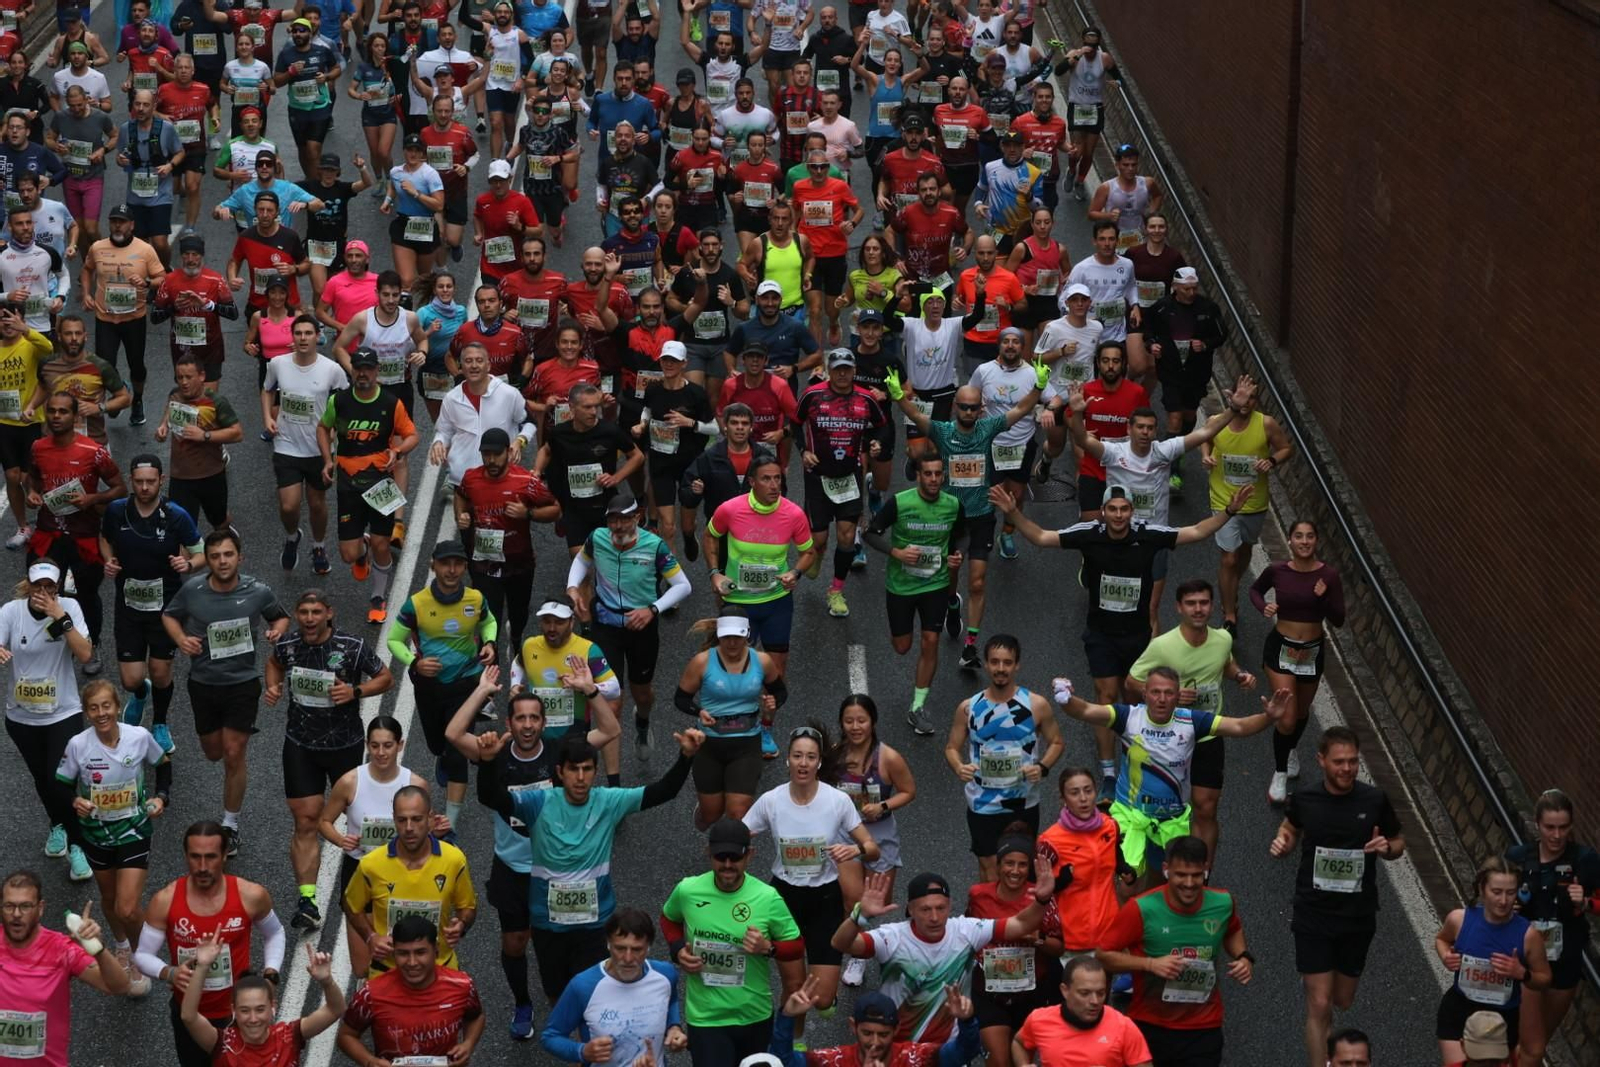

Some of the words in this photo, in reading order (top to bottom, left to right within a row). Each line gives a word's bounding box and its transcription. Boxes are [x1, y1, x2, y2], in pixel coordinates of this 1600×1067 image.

[109, 293, 129, 303] 9601
[285, 398, 308, 411] 7928
[816, 420, 865, 431] TRISPORT
[954, 463, 977, 474] 5341
[1227, 461, 1250, 474] 7592
[743, 572, 769, 584] 8263
[128, 586, 155, 599] 9068
[1103, 585, 1134, 598] 10413
[214, 629, 242, 643] 9924
[17, 684, 50, 698] 15094
[296, 677, 324, 692] 8258
[984, 758, 1013, 772] 7925
[94, 790, 131, 806] 12417
[364, 826, 397, 840] 1002
[785, 846, 816, 860] 6904
[1321, 859, 1354, 874] 7625
[556, 892, 587, 906] 8528
[700, 951, 734, 969] 9045
[0, 1022, 33, 1039] 7401
